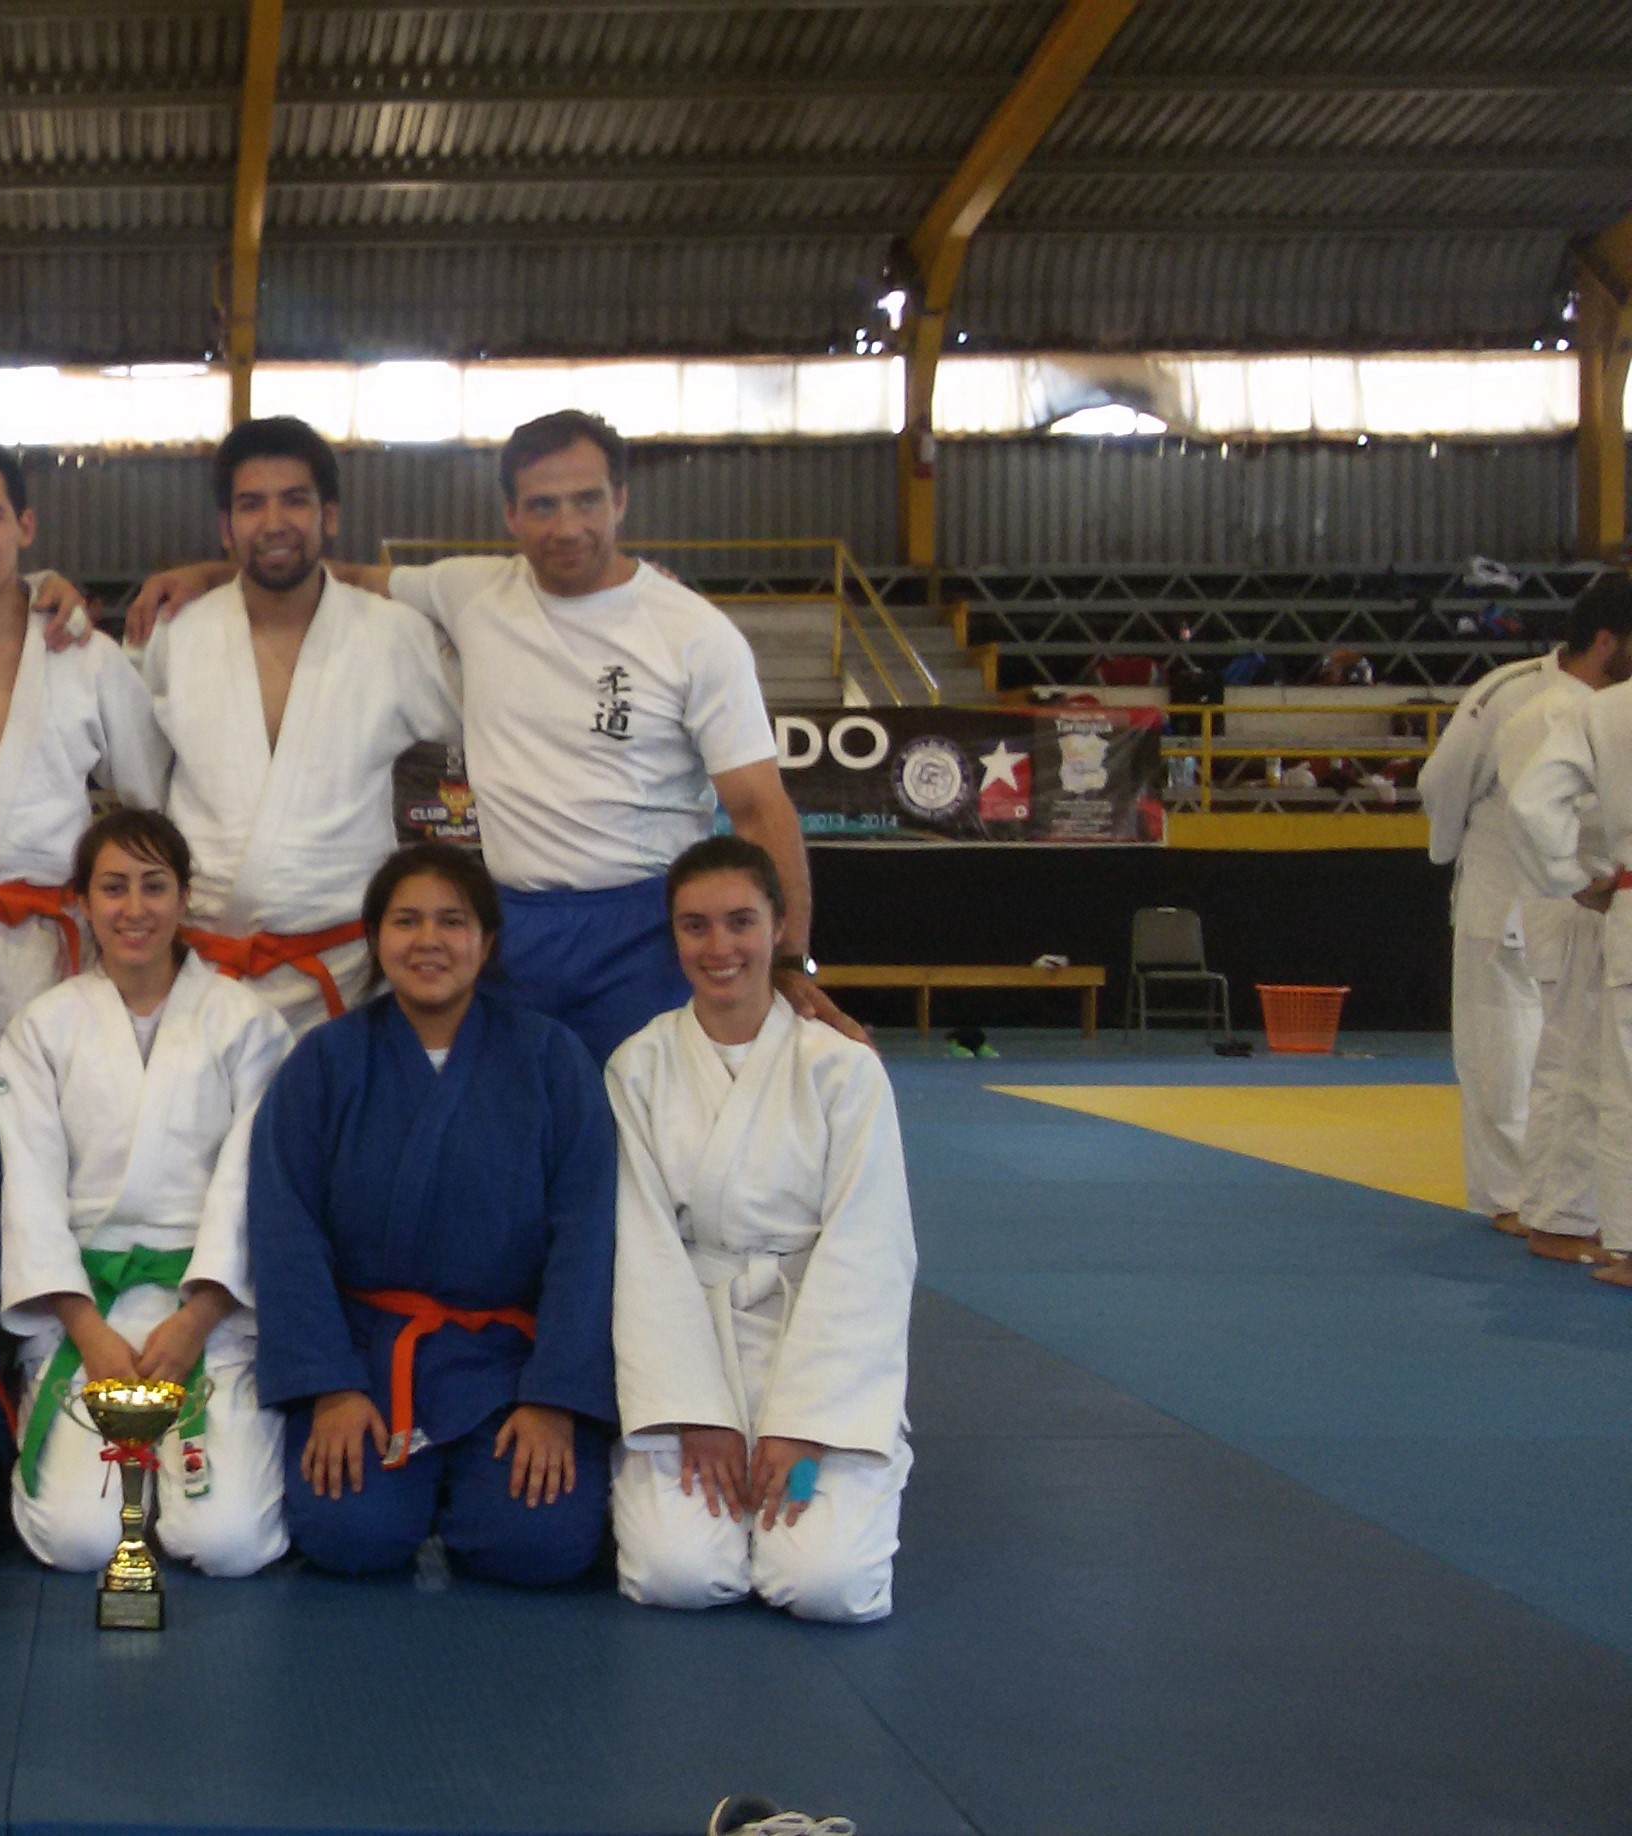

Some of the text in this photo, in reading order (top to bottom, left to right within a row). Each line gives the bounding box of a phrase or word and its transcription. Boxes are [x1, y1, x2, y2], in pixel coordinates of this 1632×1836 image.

[590, 666, 634, 740] 柔道
[410, 806, 447, 820] CLUB
[861, 813, 898, 829] 2014
